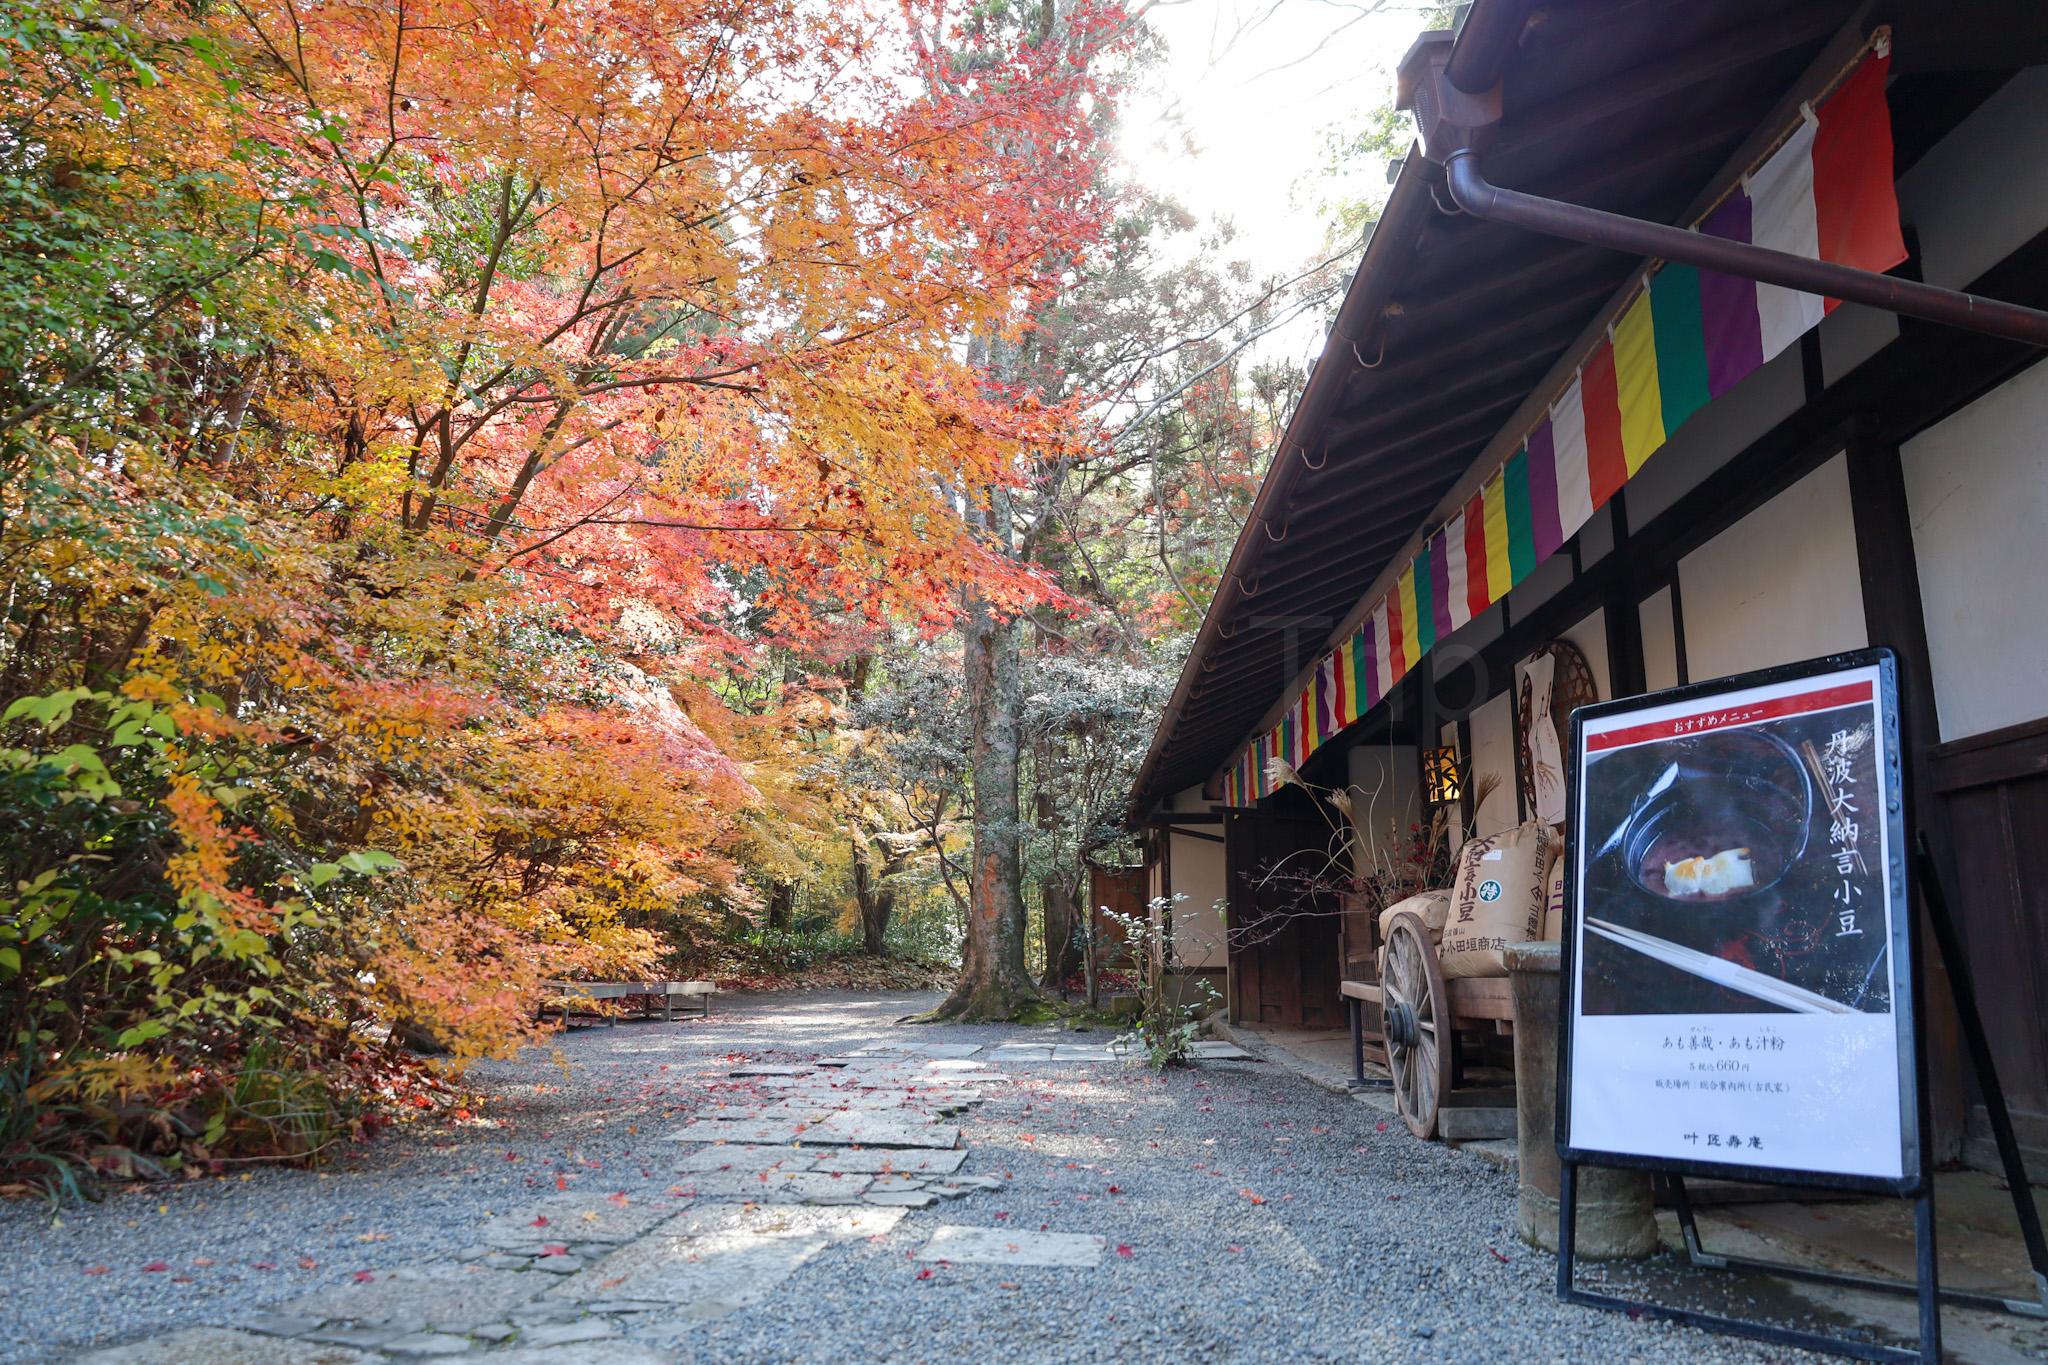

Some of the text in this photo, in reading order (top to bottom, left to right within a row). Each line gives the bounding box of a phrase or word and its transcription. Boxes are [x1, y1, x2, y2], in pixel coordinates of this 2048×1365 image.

[1674, 709, 1763, 733] おすすめメニュー
[1825, 729, 1863, 937] 丹波大納言小豆
